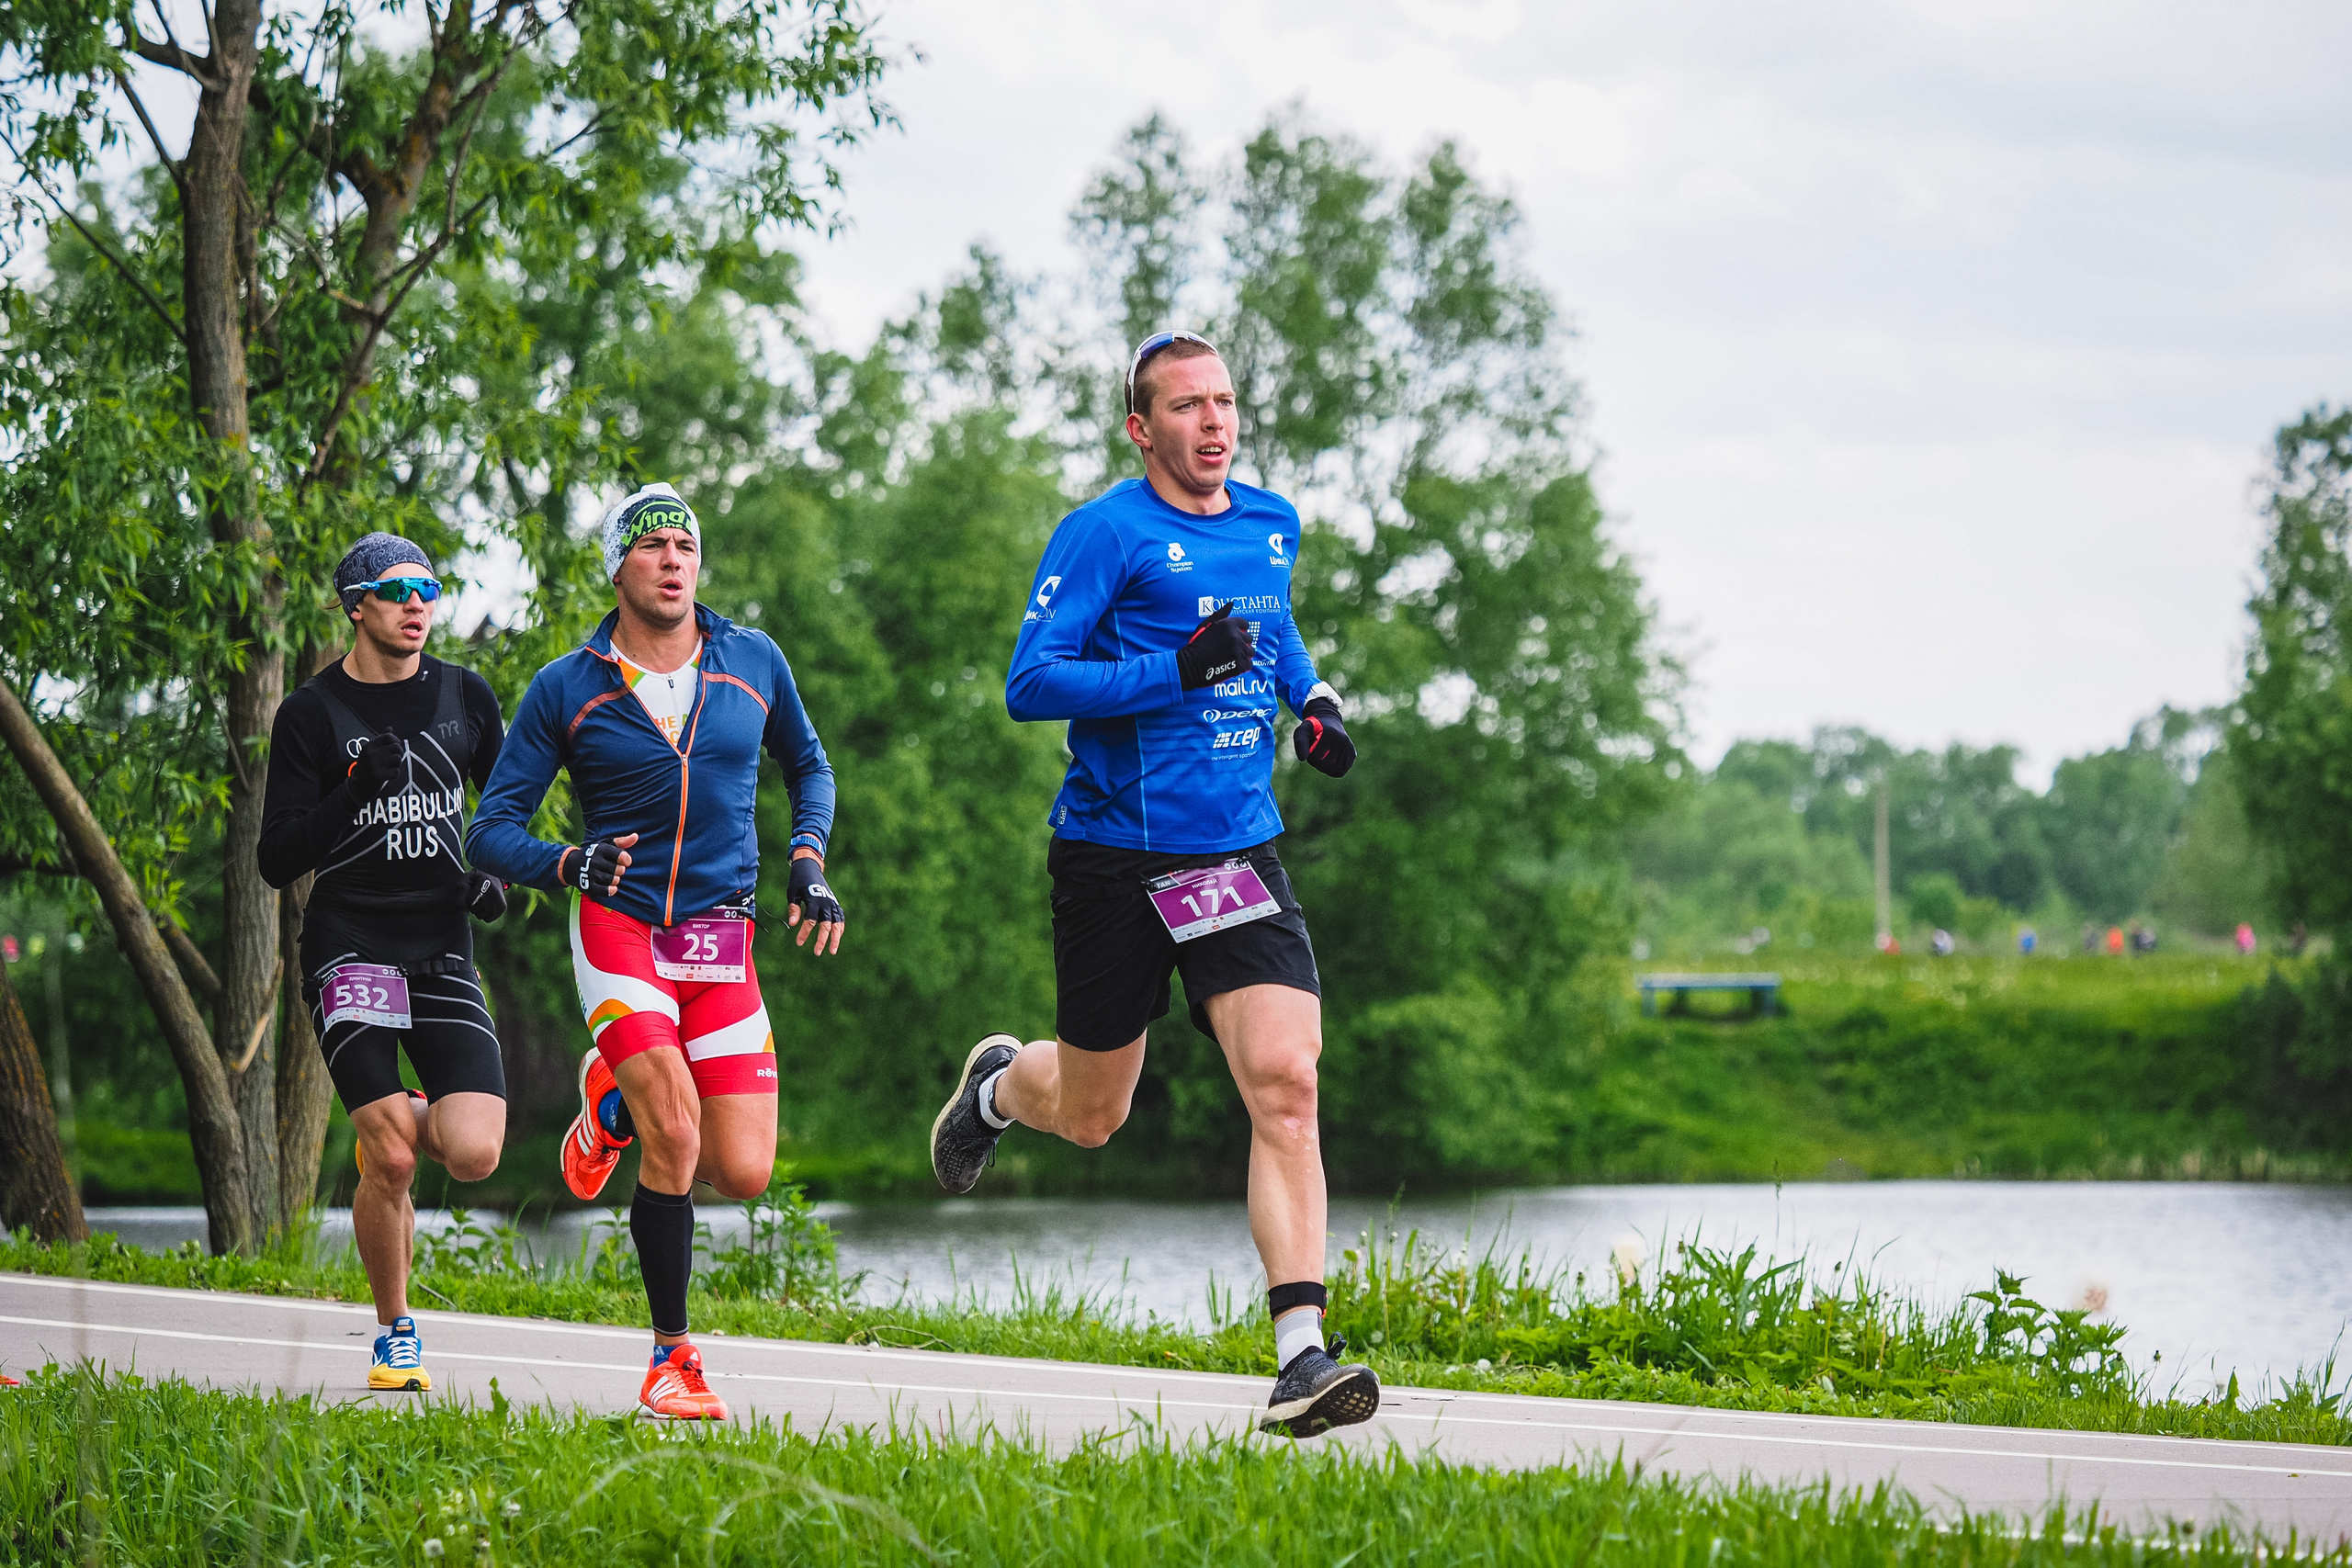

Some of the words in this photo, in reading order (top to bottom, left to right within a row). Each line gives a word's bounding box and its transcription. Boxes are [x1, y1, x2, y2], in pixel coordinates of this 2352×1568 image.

[1215, 660, 1237, 675] asics
[437, 719, 460, 739] TYR
[653, 716, 677, 730] HE
[353, 786, 465, 826] HABIBULLIN
[387, 825, 439, 861] RUS
[1181, 886, 1245, 917] 171
[682, 933, 718, 962] 25
[335, 984, 390, 1010] 532
